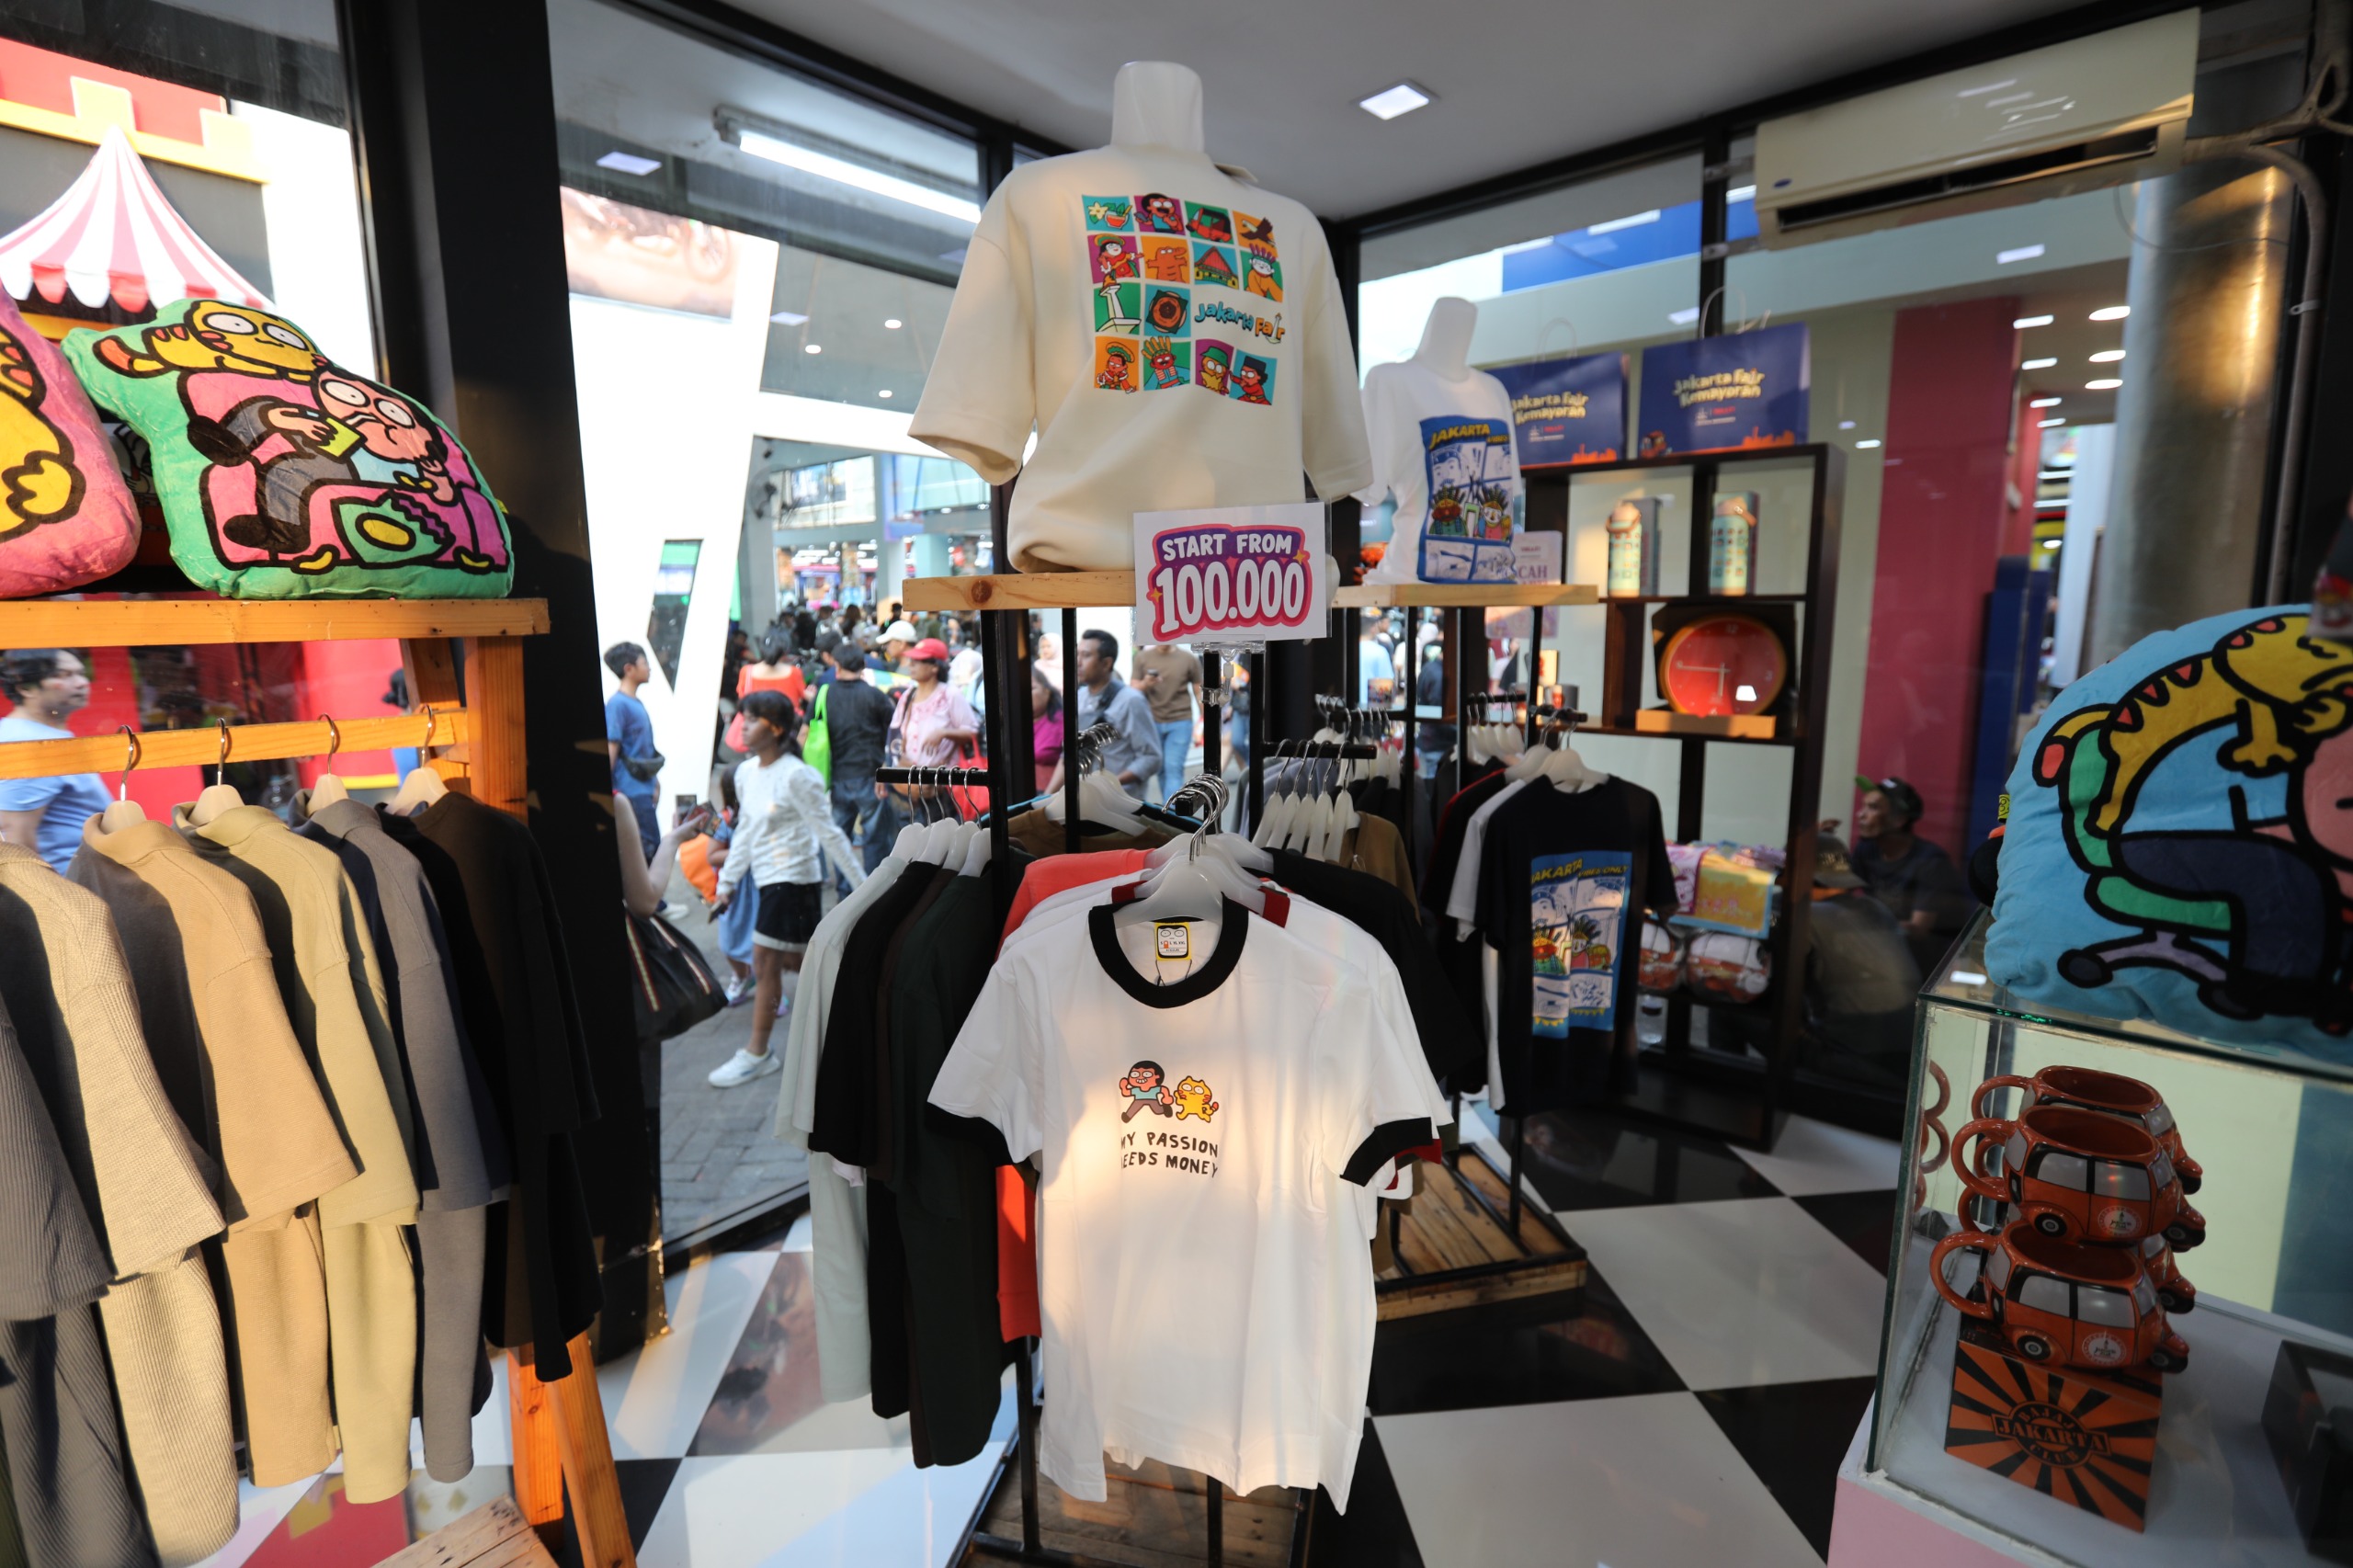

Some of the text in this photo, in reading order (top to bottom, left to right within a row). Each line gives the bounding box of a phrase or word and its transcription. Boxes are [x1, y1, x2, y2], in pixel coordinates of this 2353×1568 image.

[1195, 301, 1286, 343] Jakarta Fair
[1674, 373, 1733, 396] Jakarta
[1679, 384, 1761, 408] Kemayoran
[1428, 424, 1491, 451] JAKARTA
[1162, 533, 1292, 562] START FROM
[1155, 558, 1305, 633] 100.000
[1603, 865, 1629, 875] ONLY
[1146, 1131, 1219, 1158] PASSION
[1121, 1152, 1219, 1178] EEDS MONEY
[1998, 1420, 2104, 1451] JAKARTA
[2029, 1443, 2079, 1463] CLUB
